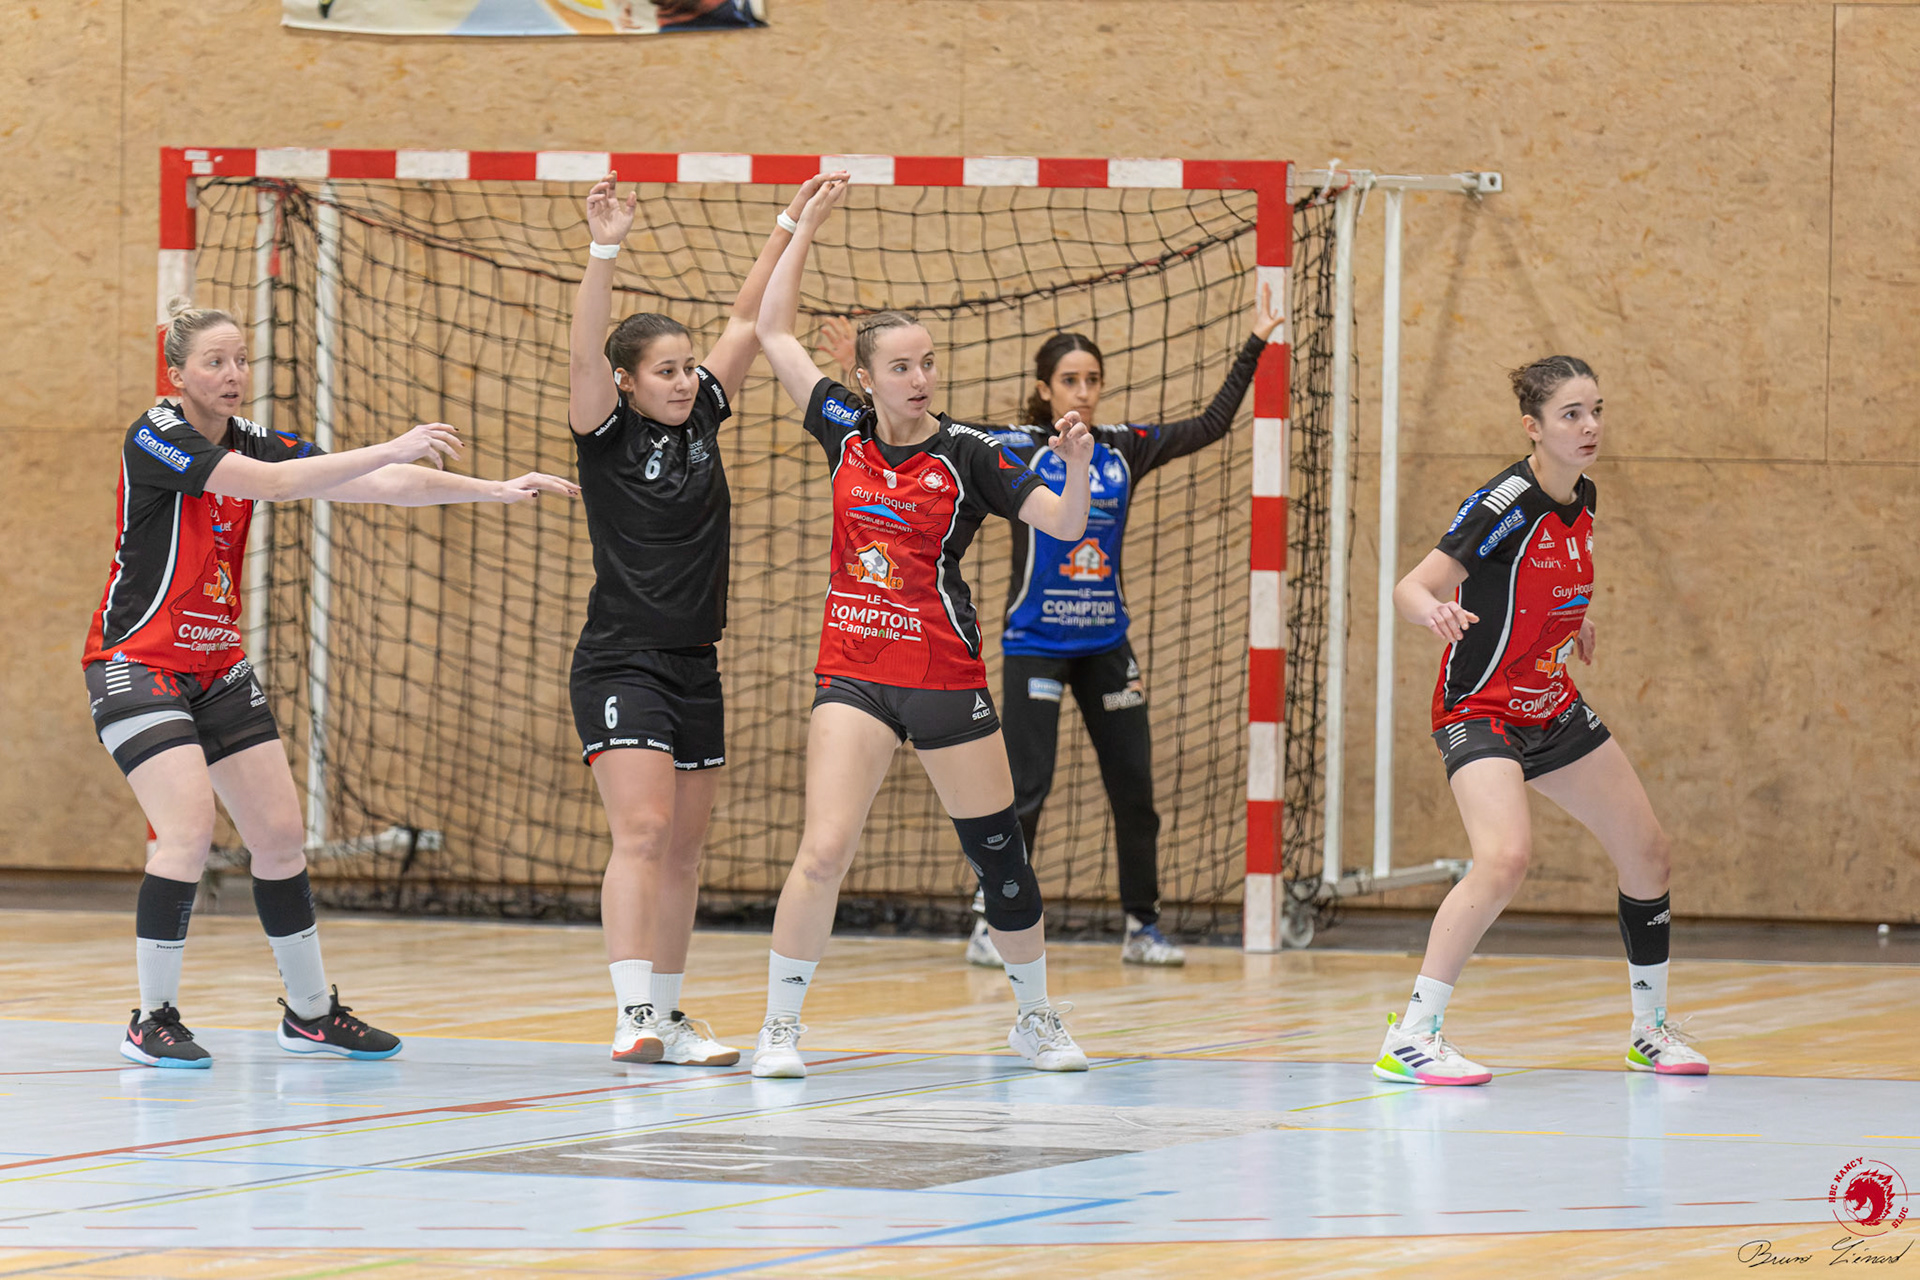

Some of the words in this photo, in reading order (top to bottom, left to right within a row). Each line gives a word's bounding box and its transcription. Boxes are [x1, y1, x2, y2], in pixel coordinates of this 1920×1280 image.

[711, 383, 725, 409] Kempa
[595, 414, 618, 437] Kempa
[137, 428, 192, 468] GrandEst
[645, 450, 663, 480] 6
[851, 486, 873, 502] Guy
[875, 492, 917, 512] Hoquet
[1565, 536, 1582, 573] 4
[866, 594, 881, 605] LE
[1552, 585, 1573, 599] Guy
[217, 615, 230, 624] LE
[839, 620, 900, 641] Campanile
[604, 696, 618, 729] 6
[972, 708, 990, 721] SELECT
[610, 737, 638, 746] Kempa
